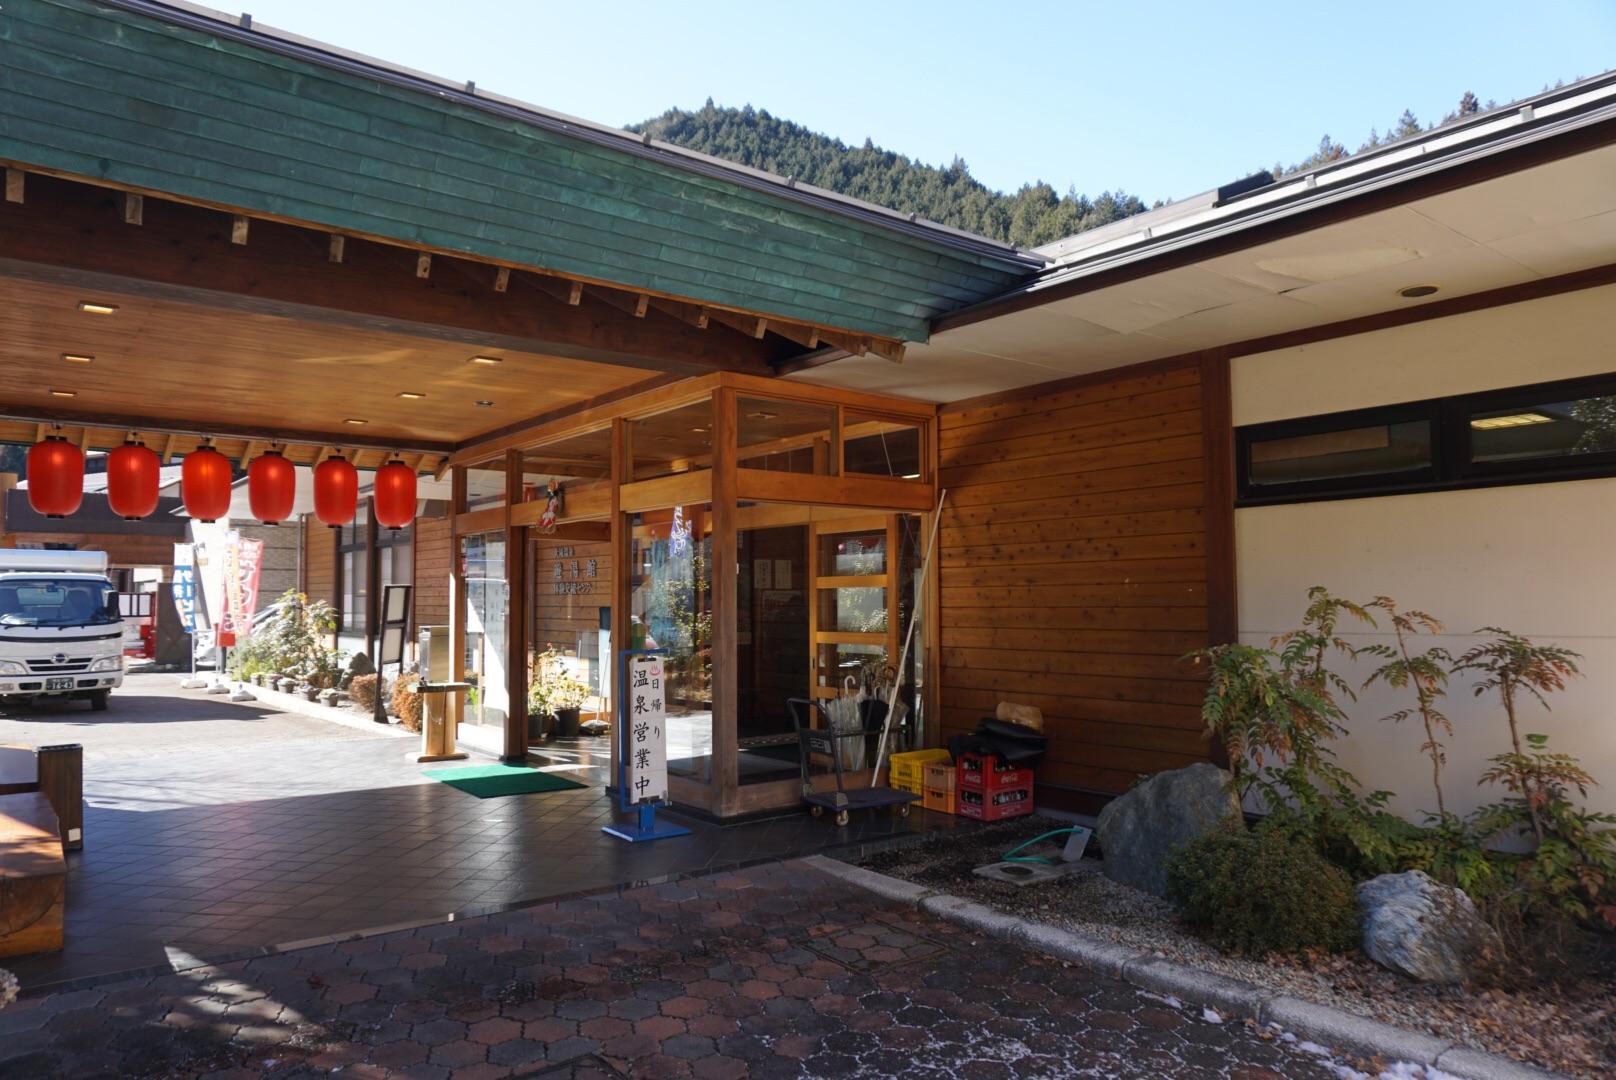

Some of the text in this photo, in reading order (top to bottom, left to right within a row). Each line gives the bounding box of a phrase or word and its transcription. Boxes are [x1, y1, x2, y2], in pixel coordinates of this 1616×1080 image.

[633, 669, 651, 796] 温泉営業中
[651, 678, 662, 740] 日帰り
